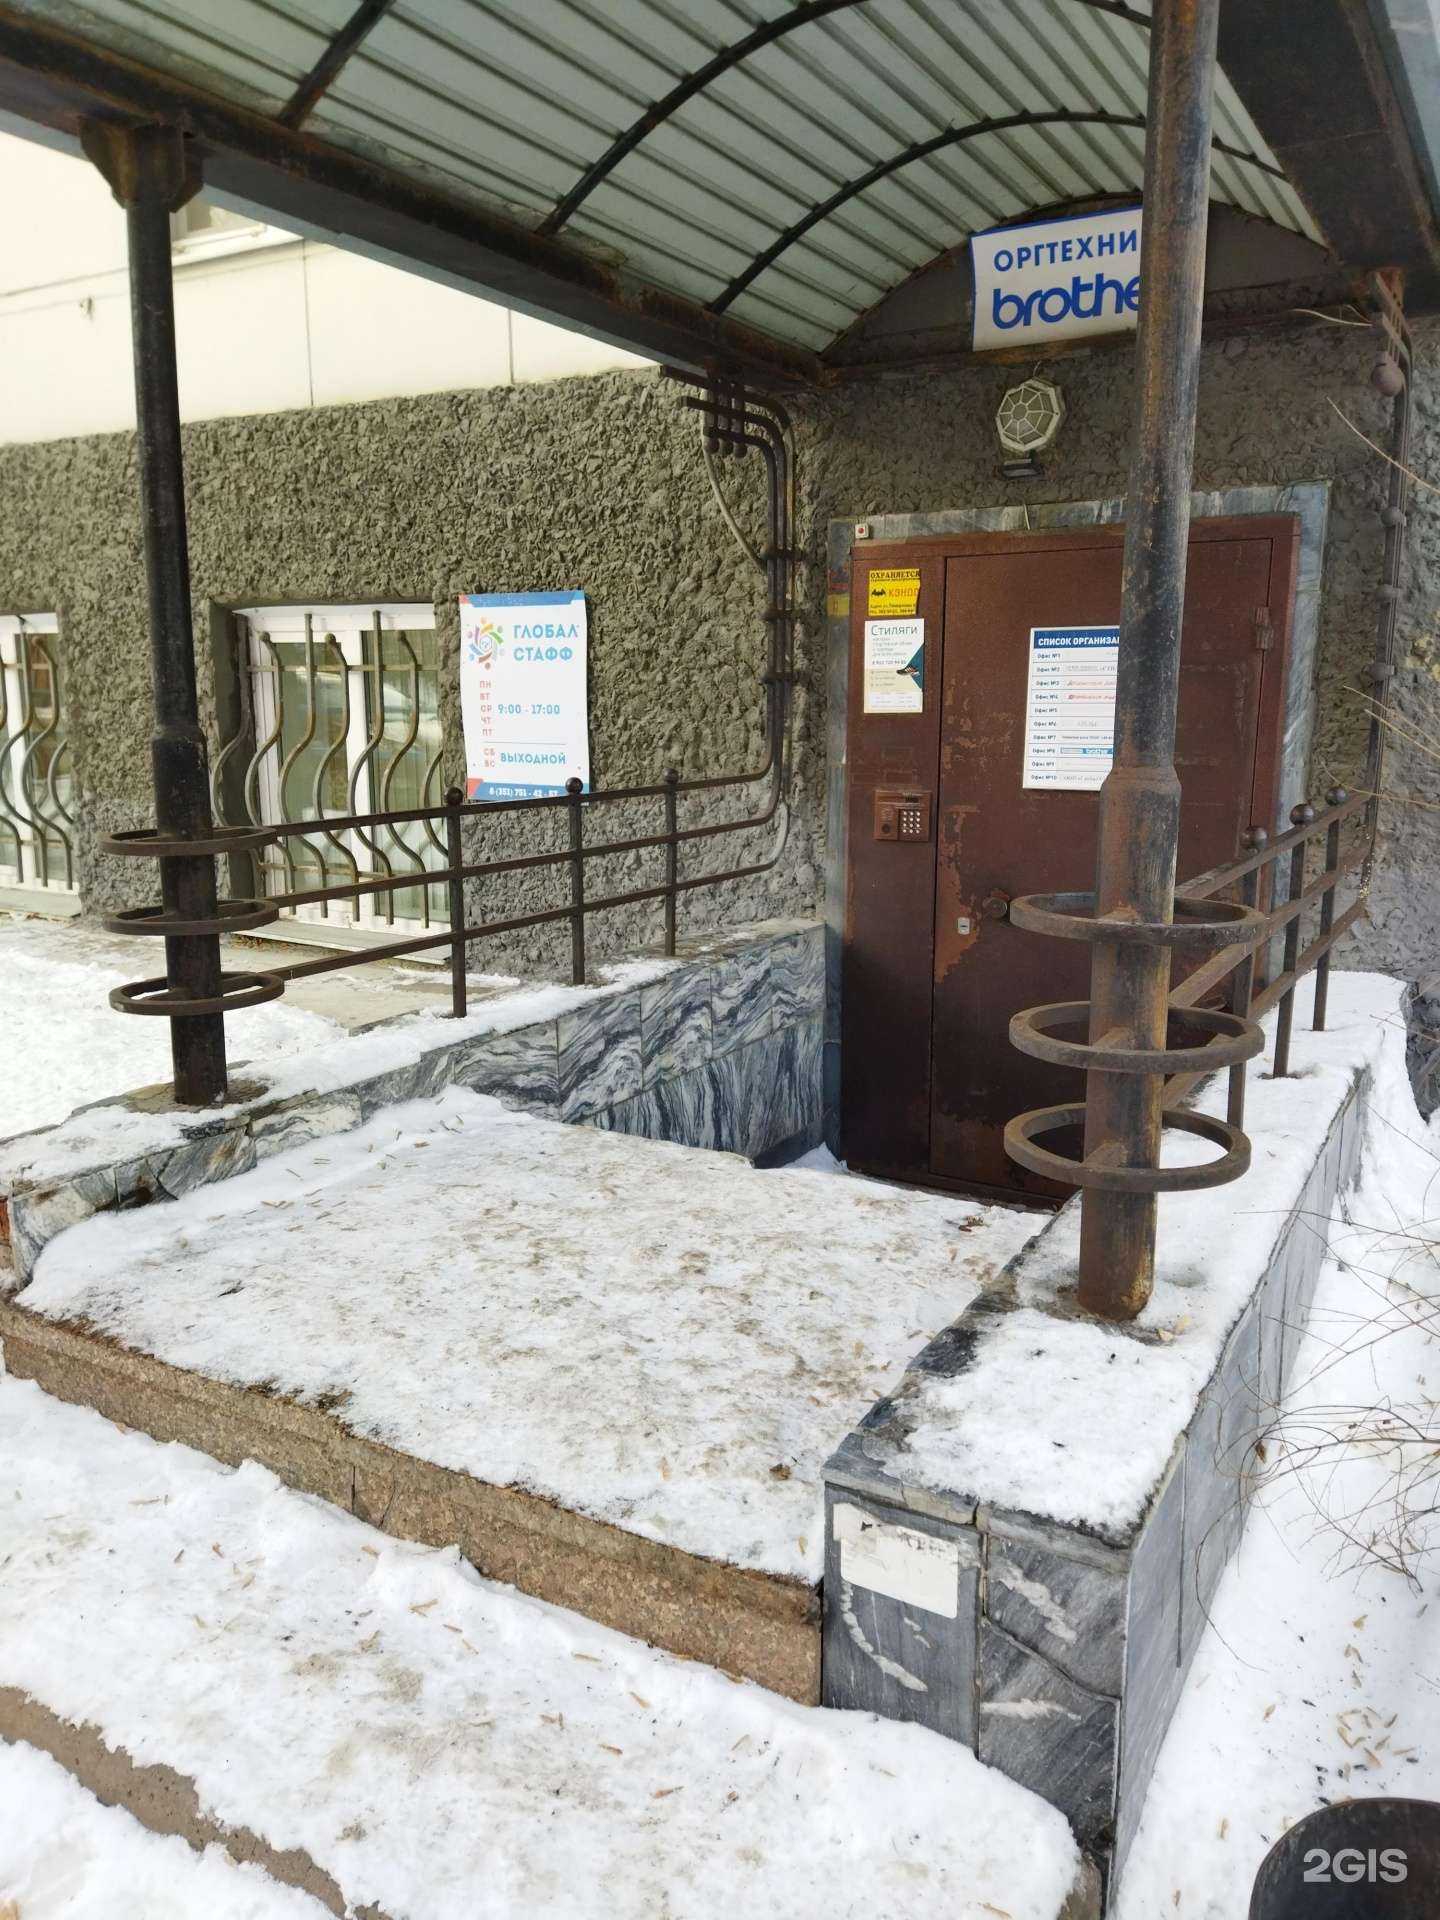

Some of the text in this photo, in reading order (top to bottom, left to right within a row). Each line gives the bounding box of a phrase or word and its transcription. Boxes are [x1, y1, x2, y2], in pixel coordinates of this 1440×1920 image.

[994, 229, 1137, 272] ОРГТЕХНИ
[992, 273, 1141, 329] brothe
[513, 624, 577, 638] ГЛОБАЛ
[871, 625, 918, 636] Стиляги
[1038, 637, 1072, 646] СПИСОК
[513, 647, 573, 662] СТАФФ
[479, 680, 491, 688] ПН
[480, 705, 492, 713] СР
[498, 704, 521, 714] 9:00
[531, 704, 560, 714] 17:00
[481, 717, 491, 725] ЧТ
[482, 728, 492, 736] ПТ
[500, 752, 566, 765] ВЫХОДНОЙ
